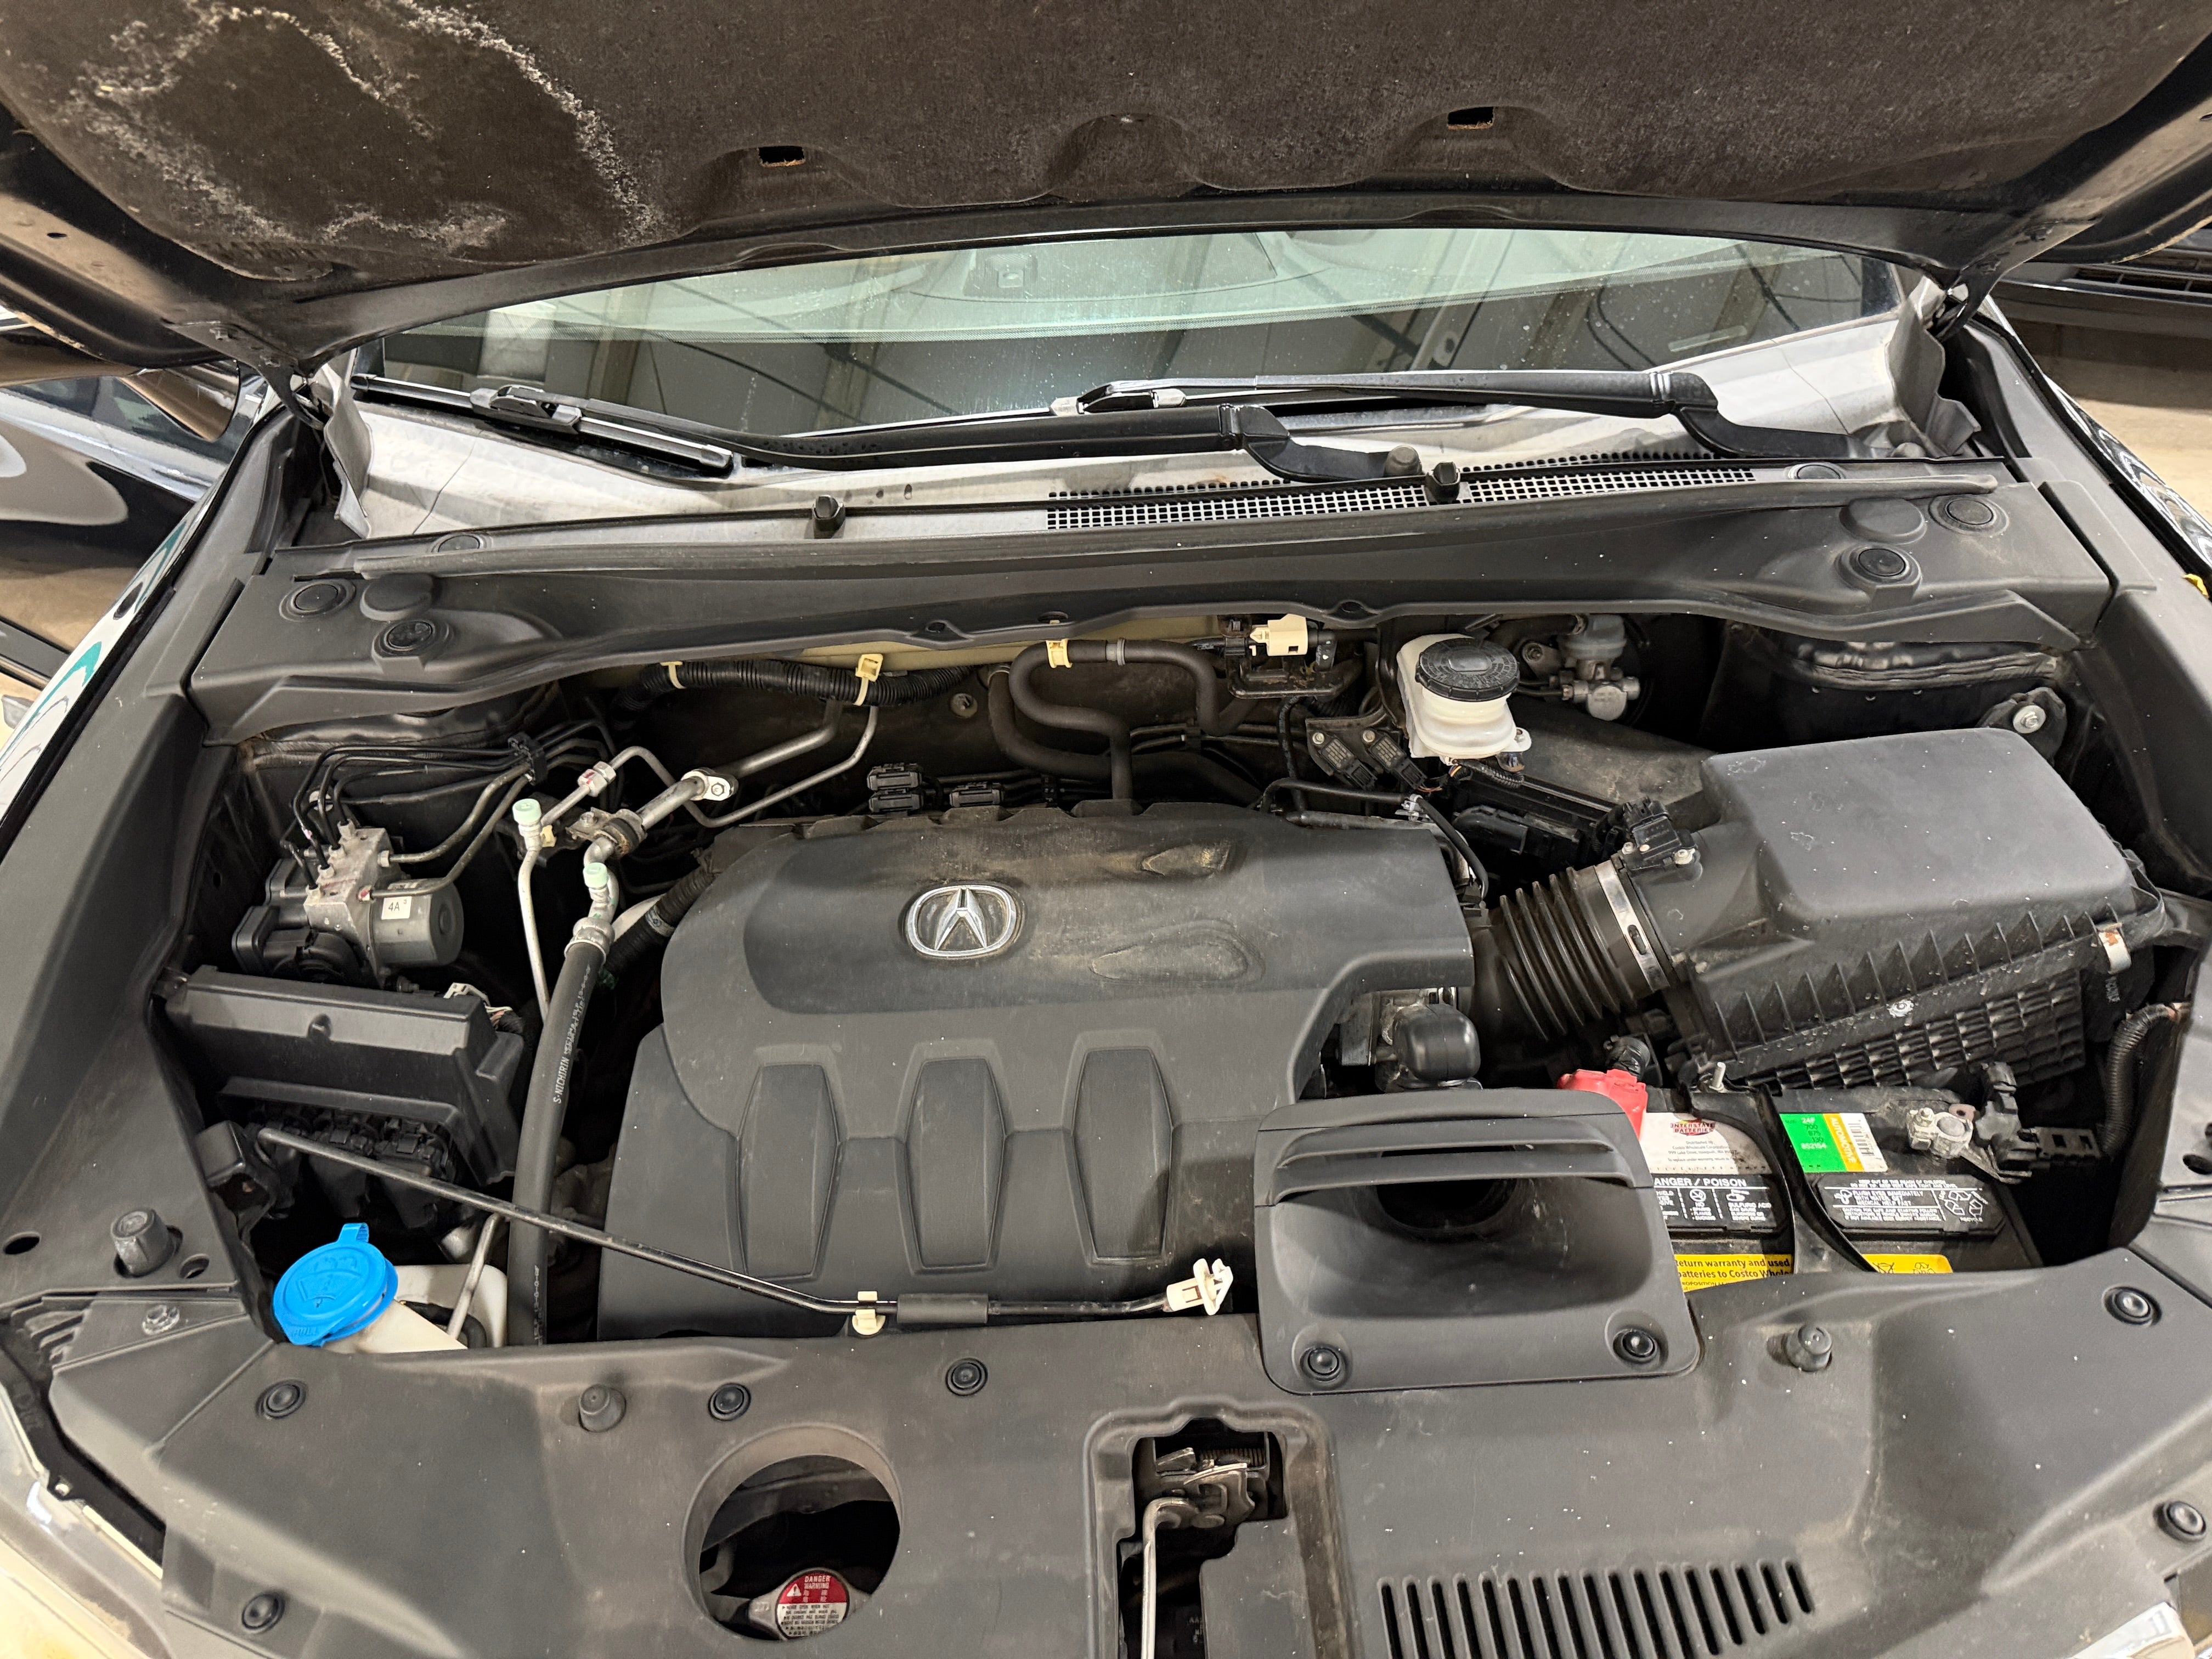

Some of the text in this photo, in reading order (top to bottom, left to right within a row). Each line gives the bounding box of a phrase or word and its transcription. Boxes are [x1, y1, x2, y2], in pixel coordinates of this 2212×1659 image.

[388, 901, 400, 912] 4A
[1830, 1118, 1857, 1164] AUTOMOTIVE
[1654, 1178, 1692, 1186] ANGER
[1703, 1178, 1747, 1187] POISON
[1705, 1259, 1746, 1268] warranty
[1748, 1259, 1766, 1267] and
[1767, 1258, 1790, 1267] used
[1729, 1269, 1758, 1278] Costco
